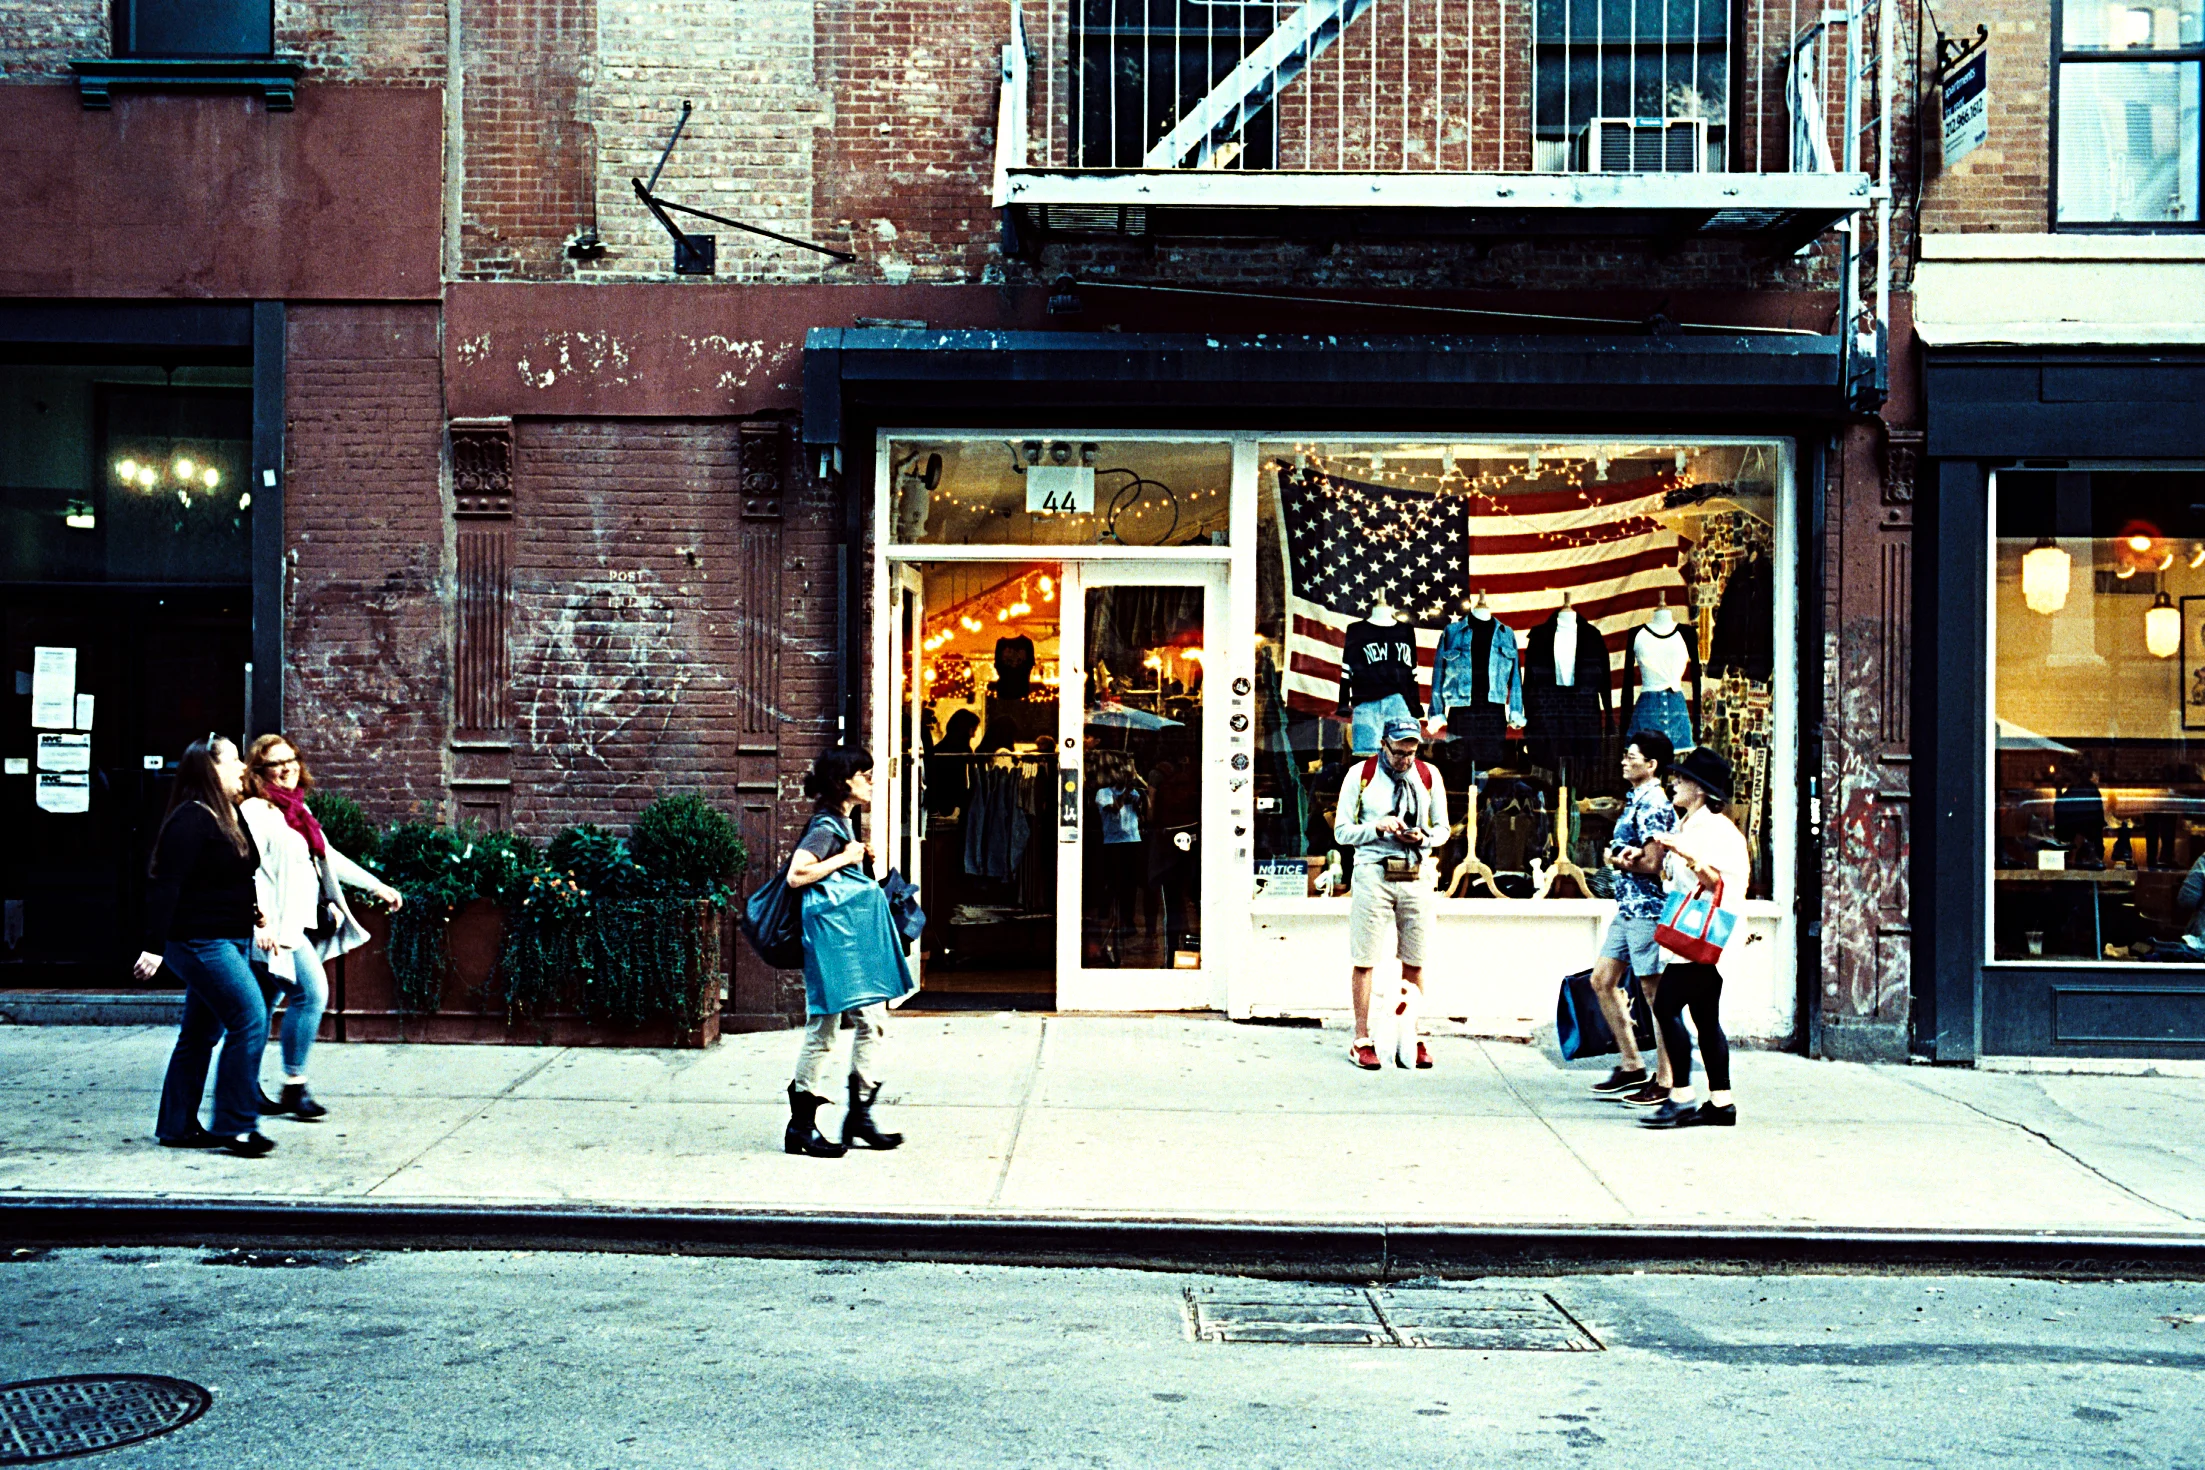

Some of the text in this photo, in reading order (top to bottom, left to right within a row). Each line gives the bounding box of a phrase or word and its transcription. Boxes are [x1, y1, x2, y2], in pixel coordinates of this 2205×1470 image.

[1945, 67, 1976, 100] apartments
[1042, 490, 1077, 515] 44
[1363, 642, 1388, 665] NEW
[1753, 750, 1765, 806] BRANDY
[1258, 864, 1304, 875] NOTICE
